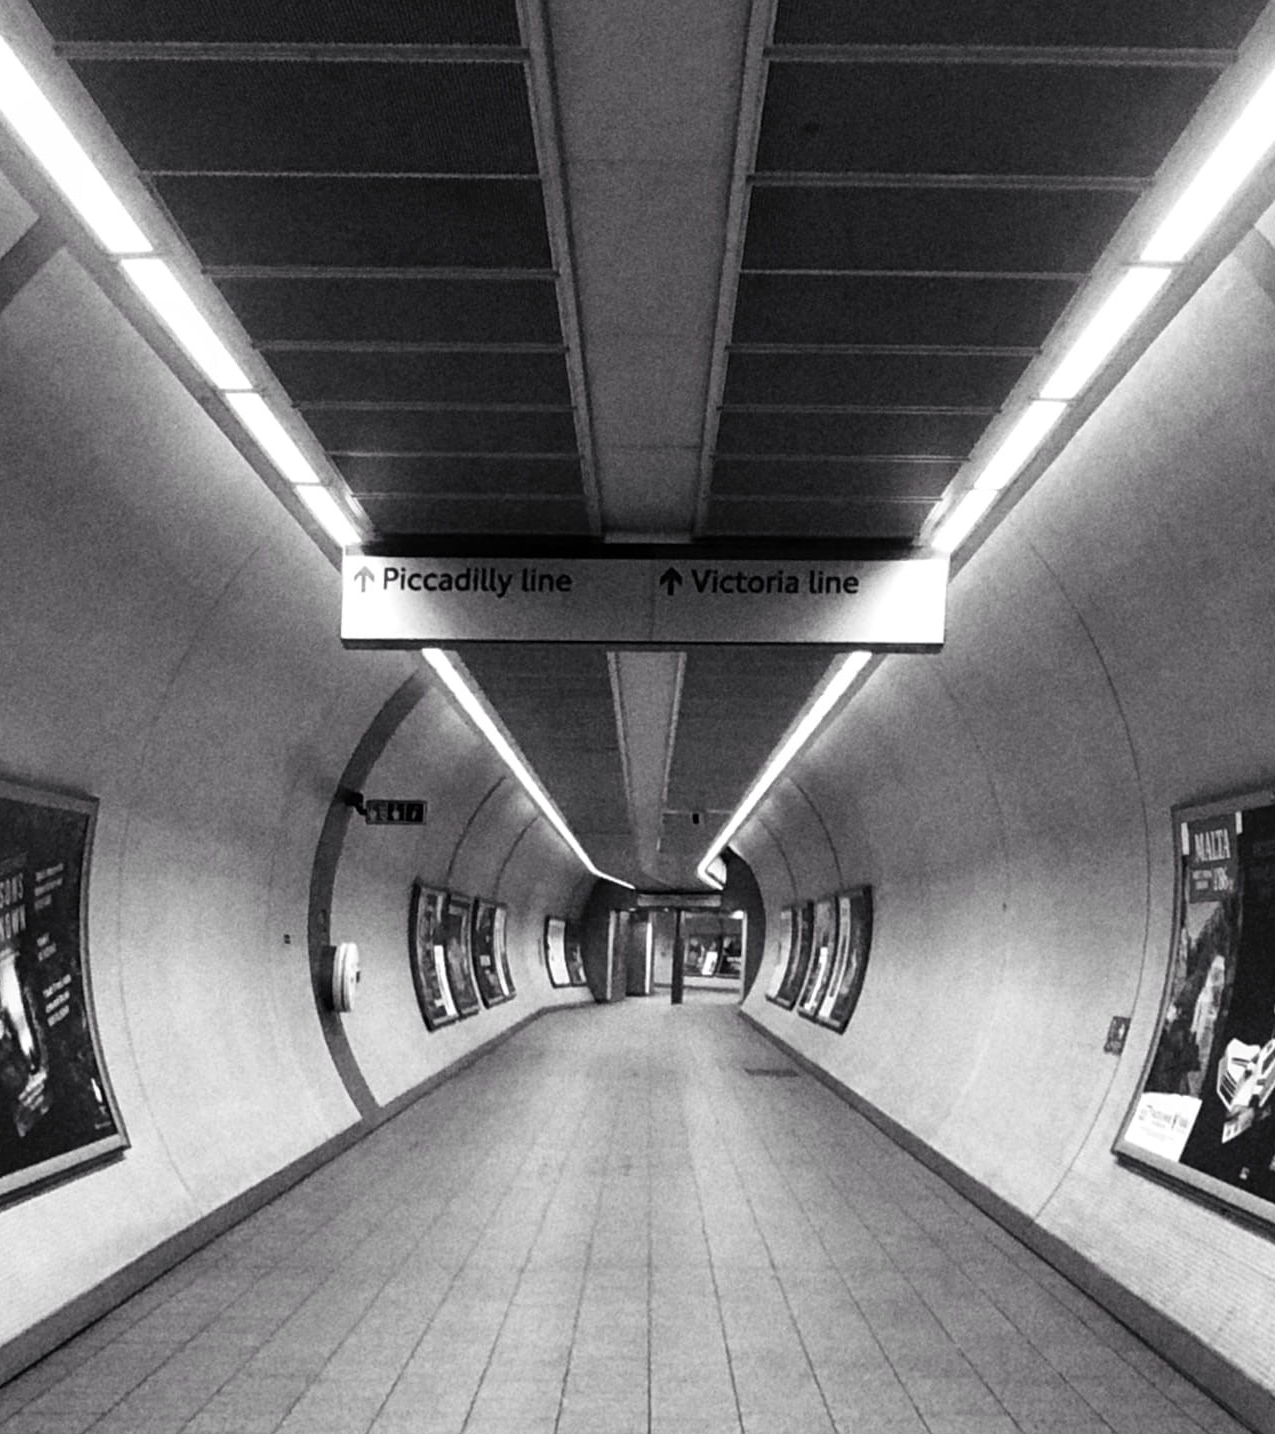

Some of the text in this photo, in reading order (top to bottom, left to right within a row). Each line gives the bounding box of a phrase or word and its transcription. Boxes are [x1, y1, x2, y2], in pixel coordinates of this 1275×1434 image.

[383, 567, 573, 598] Piccadilly line
[692, 568, 860, 595] Victoria line
[1194, 828, 1231, 863] MALTA
